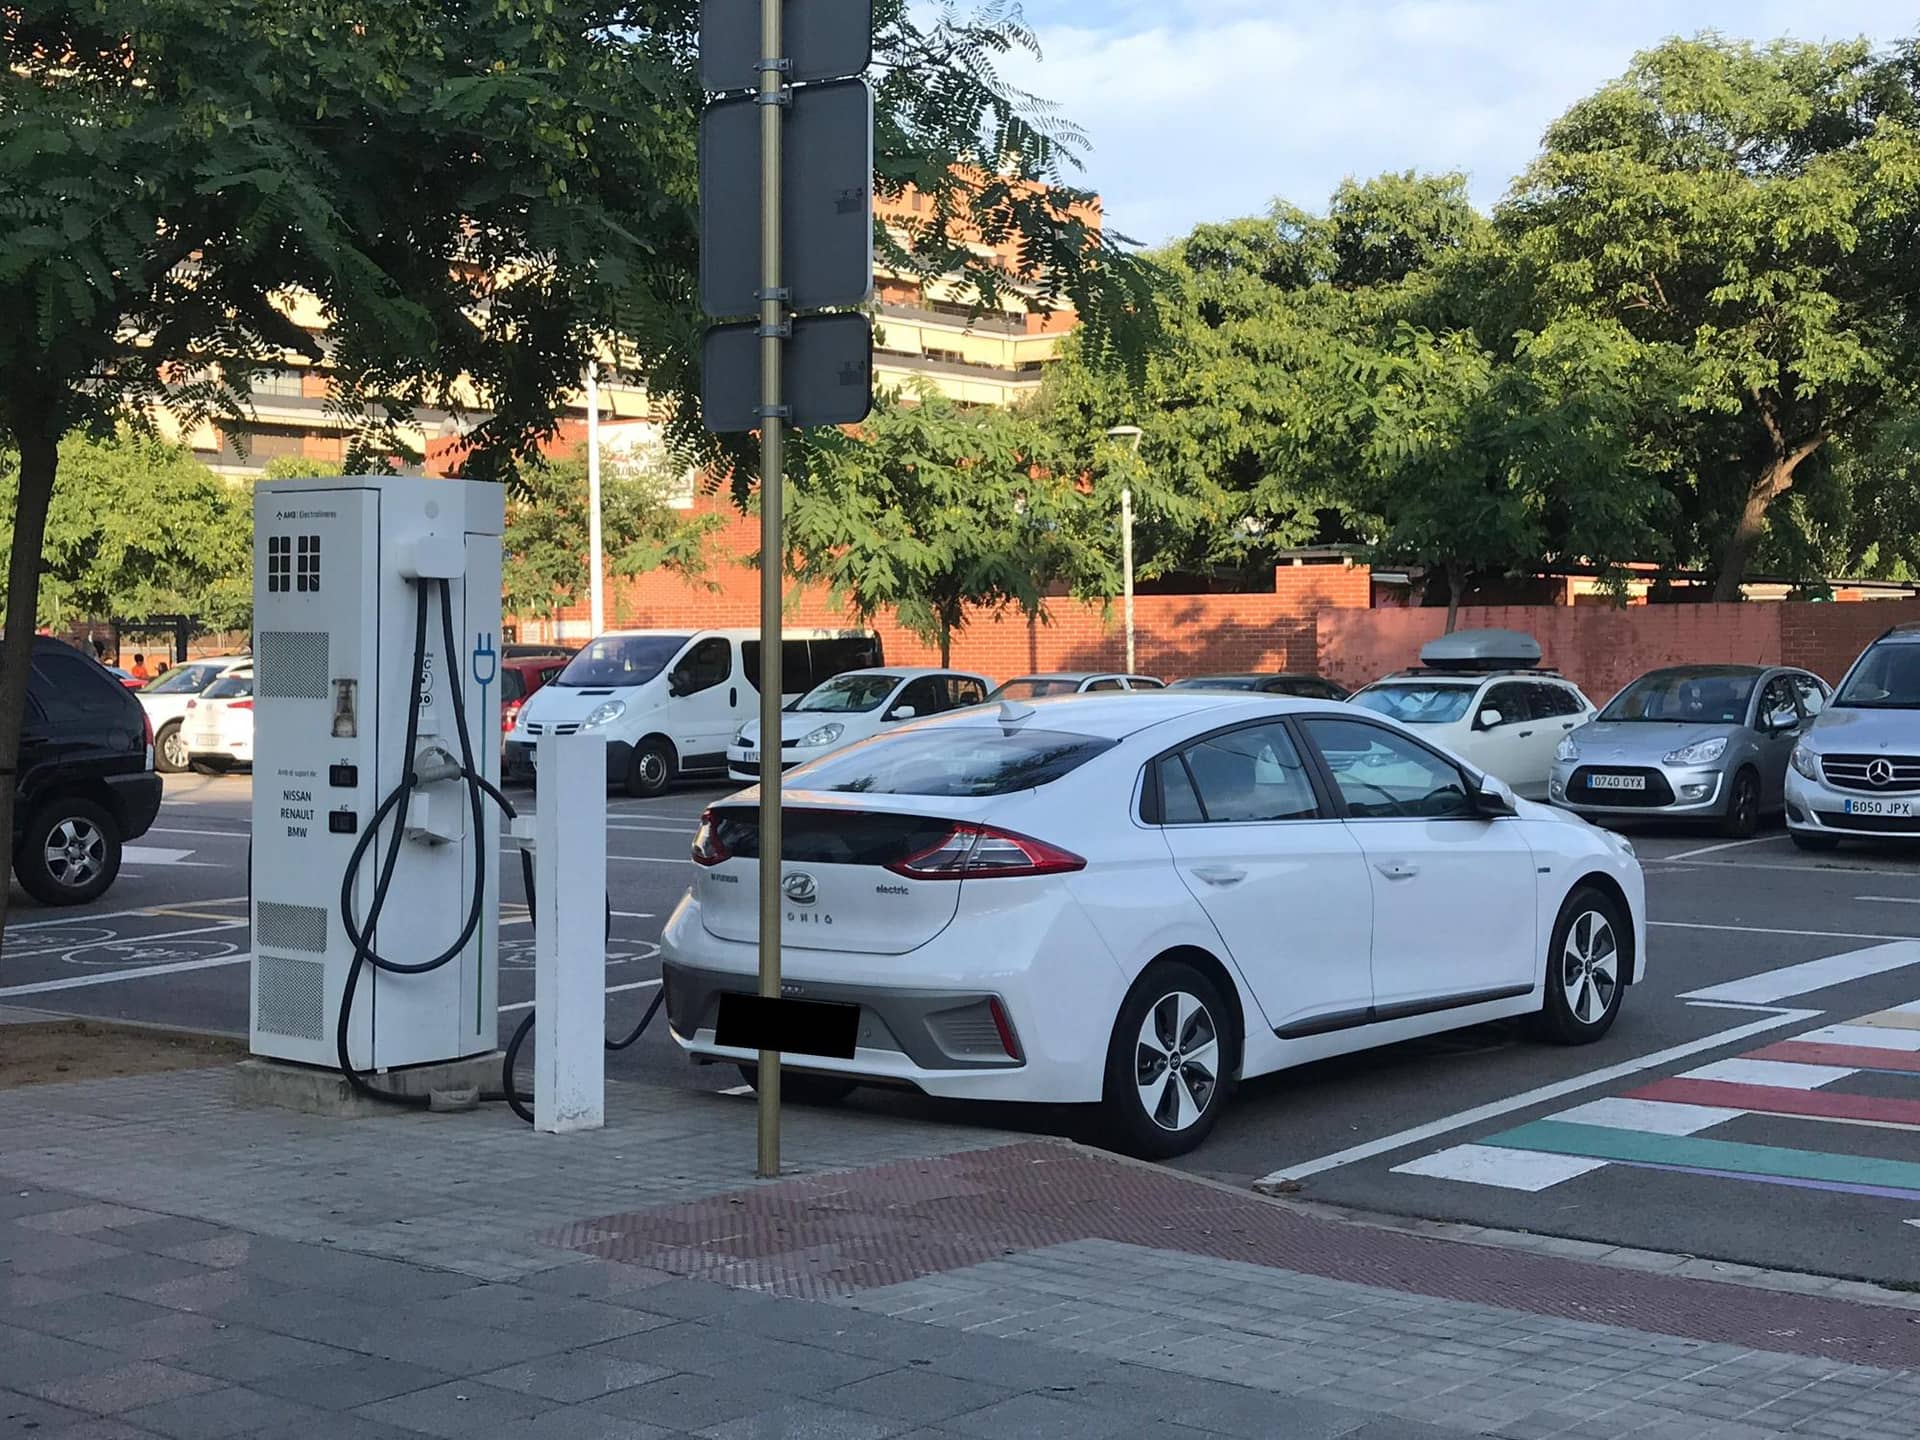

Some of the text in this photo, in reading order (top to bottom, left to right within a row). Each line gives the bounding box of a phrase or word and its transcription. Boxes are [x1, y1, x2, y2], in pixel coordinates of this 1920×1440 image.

[1594, 776, 1643, 788] 0740 GYX
[283, 790, 312, 802] NISSAN
[280, 807, 314, 820] RENAULT
[1852, 801, 1909, 815] 6050 JPX
[287, 825, 308, 838] BMW
[876, 884, 909, 895] electric
